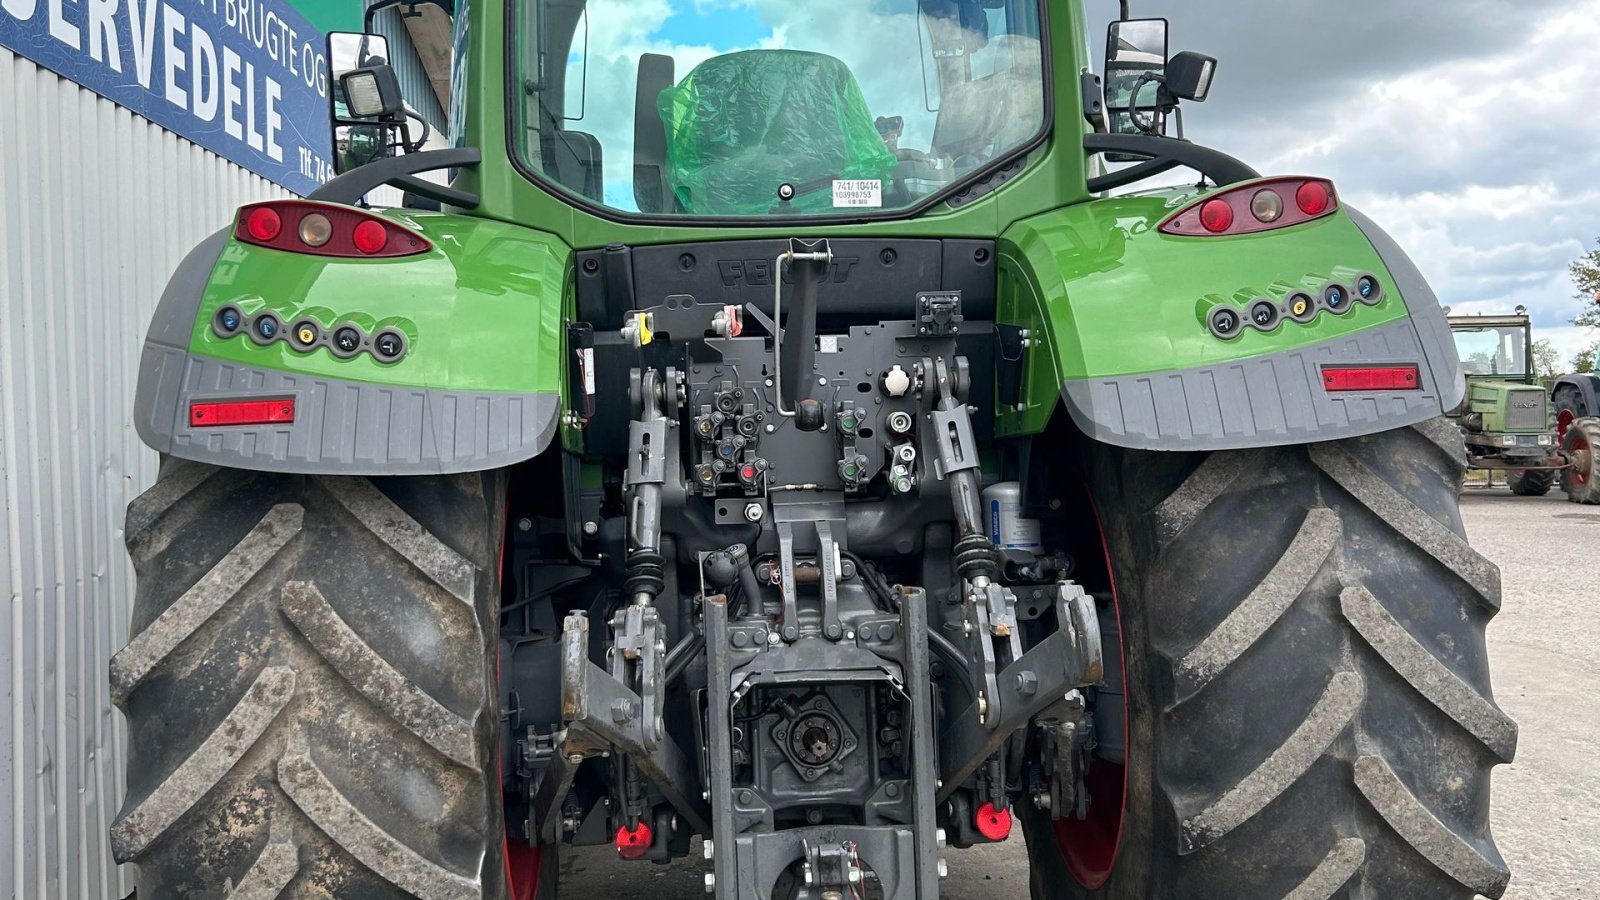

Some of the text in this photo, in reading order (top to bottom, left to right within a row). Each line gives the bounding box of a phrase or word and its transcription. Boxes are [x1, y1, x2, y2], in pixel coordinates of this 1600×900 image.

[0, 0, 283, 162] RVEDELE
[303, 43, 325, 97] OG
[299, 146, 314, 179] Tlf.
[315, 156, 326, 184] 74
[717, 256, 860, 287] FET
